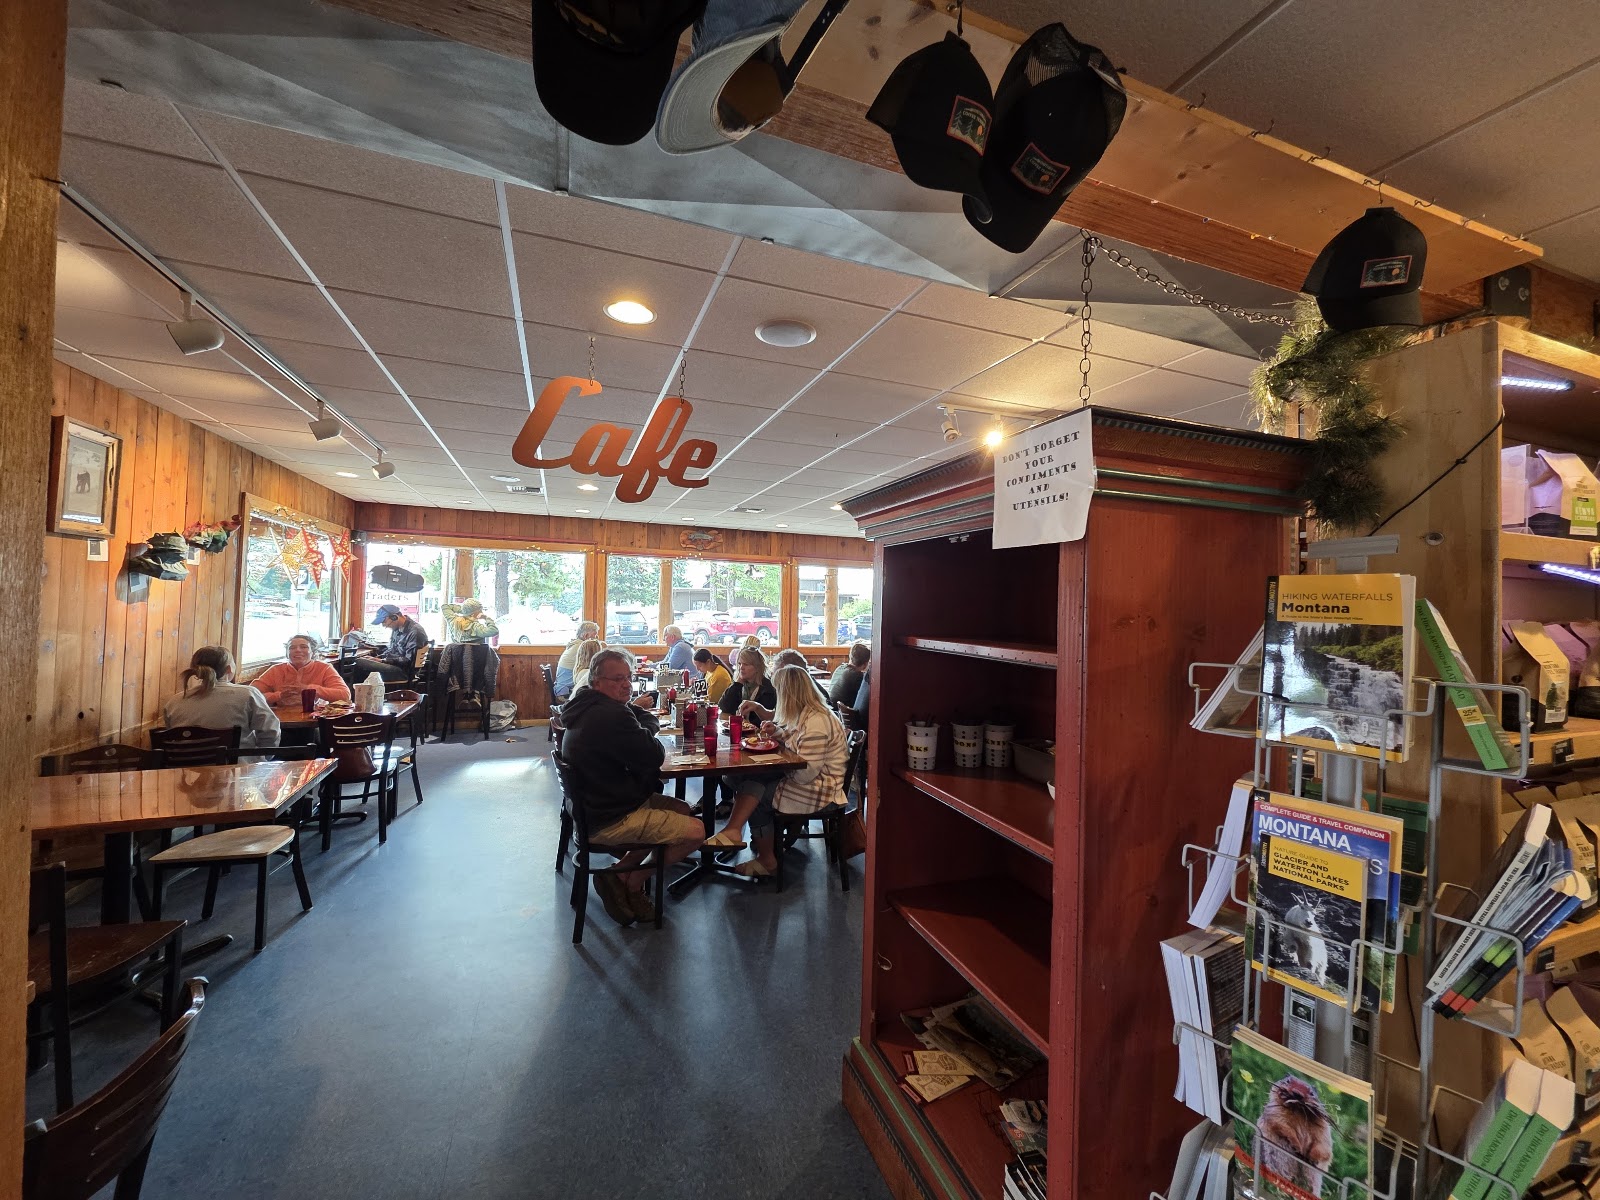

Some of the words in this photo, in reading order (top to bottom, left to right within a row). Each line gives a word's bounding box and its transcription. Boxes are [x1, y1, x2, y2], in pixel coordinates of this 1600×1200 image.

[512, 376, 718, 503] Cafe
[1002, 448, 1030, 463] DON'T
[1034, 431, 1080, 454] FORGET
[1025, 454, 1054, 470] YOUR
[1006, 462, 1077, 488] CONDIMENTS
[1028, 484, 1050, 494] AND
[1012, 492, 1069, 511] UTENSILS!
[1282, 592, 1318, 600] HIKING
[1322, 592, 1392, 601] WATERFALLS
[1282, 602, 1350, 614] Montana
[696, 681, 706, 692] 22
[1260, 804, 1292, 817] COMPLETE
[1292, 812, 1311, 821] GUIDE
[1318, 817, 1342, 829] TRAVEL
[1344, 824, 1385, 840] COMPANION
[1258, 814, 1352, 852] MONTANA
[1274, 846, 1298, 857] NATURE
[1299, 852, 1318, 862] GUIDE
[1274, 852, 1308, 866] GLACIER
[1310, 862, 1329, 872] AND
[1273, 858, 1320, 876] WATERTON
[1321, 872, 1350, 886] LAKES
[1273, 864, 1314, 883] NATIONAL
[1316, 878, 1345, 892] PARKS
